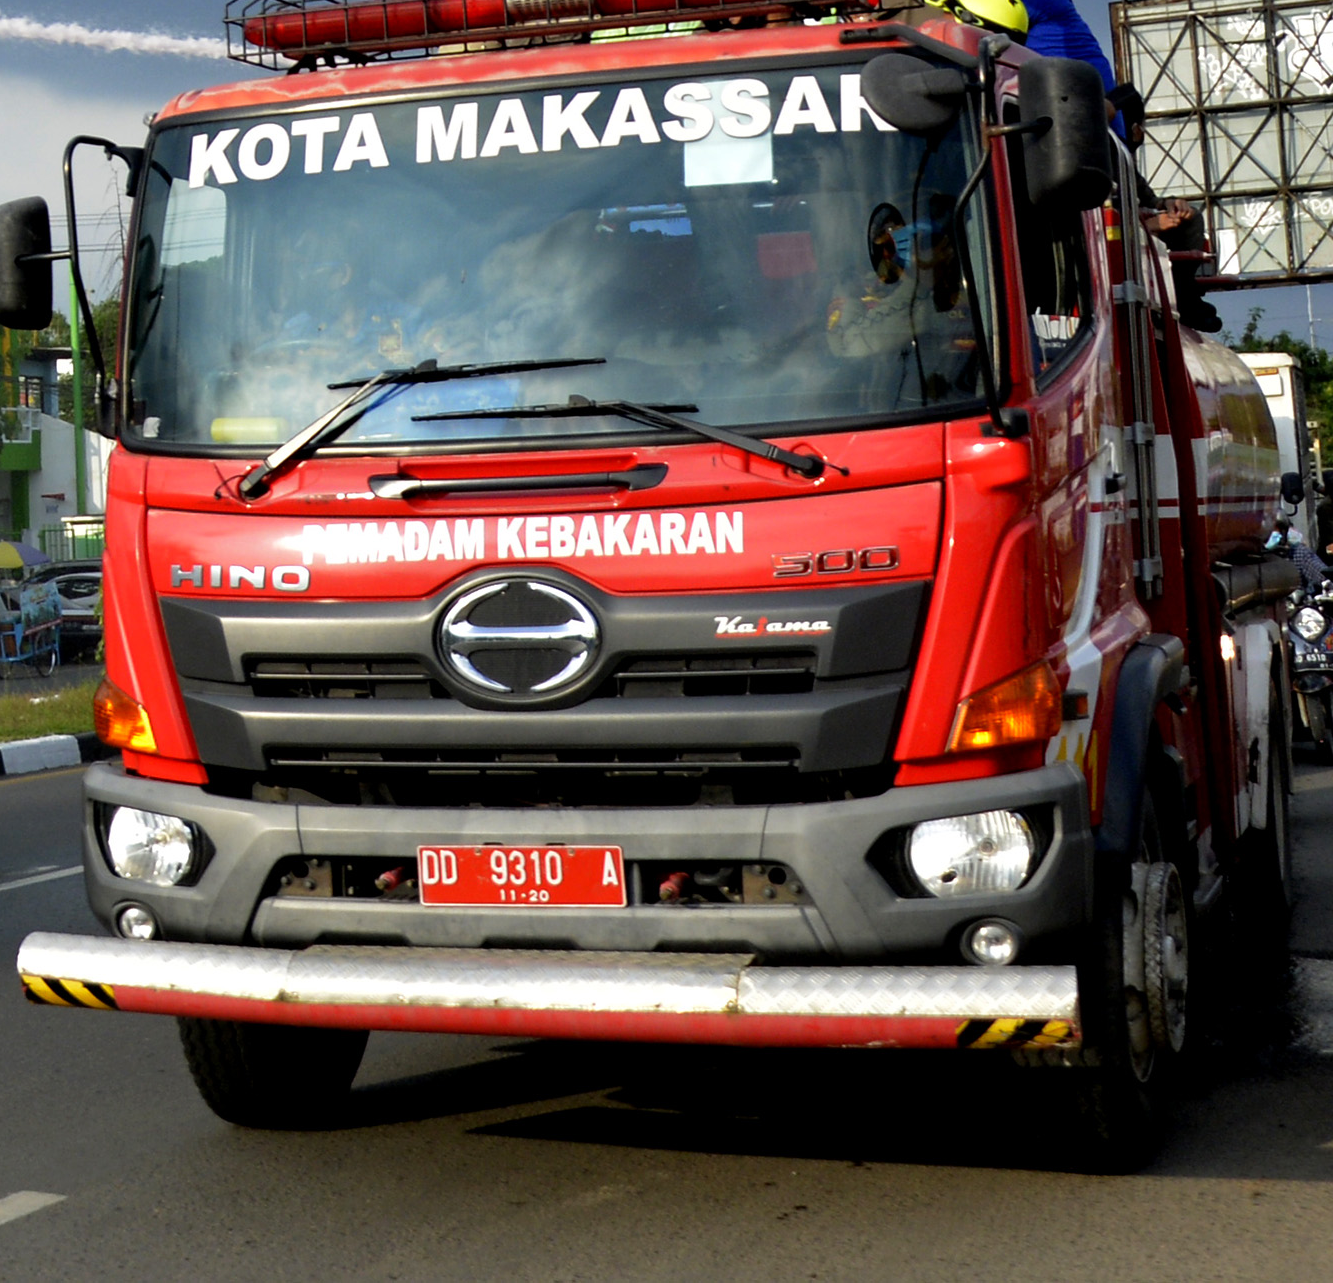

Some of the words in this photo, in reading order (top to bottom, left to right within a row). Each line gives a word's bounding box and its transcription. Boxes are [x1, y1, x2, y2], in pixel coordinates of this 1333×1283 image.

[188, 112, 389, 188] KOTA
[302, 519, 484, 564] PEMADAM
[497, 511, 744, 558] KEBAKARAN
[170, 563, 311, 593] HINO
[771, 545, 900, 579] 500
[422, 849, 458, 885] DD
[489, 849, 563, 886] 9310
[601, 850, 619, 886] A
[499, 888, 550, 902] 11-20
